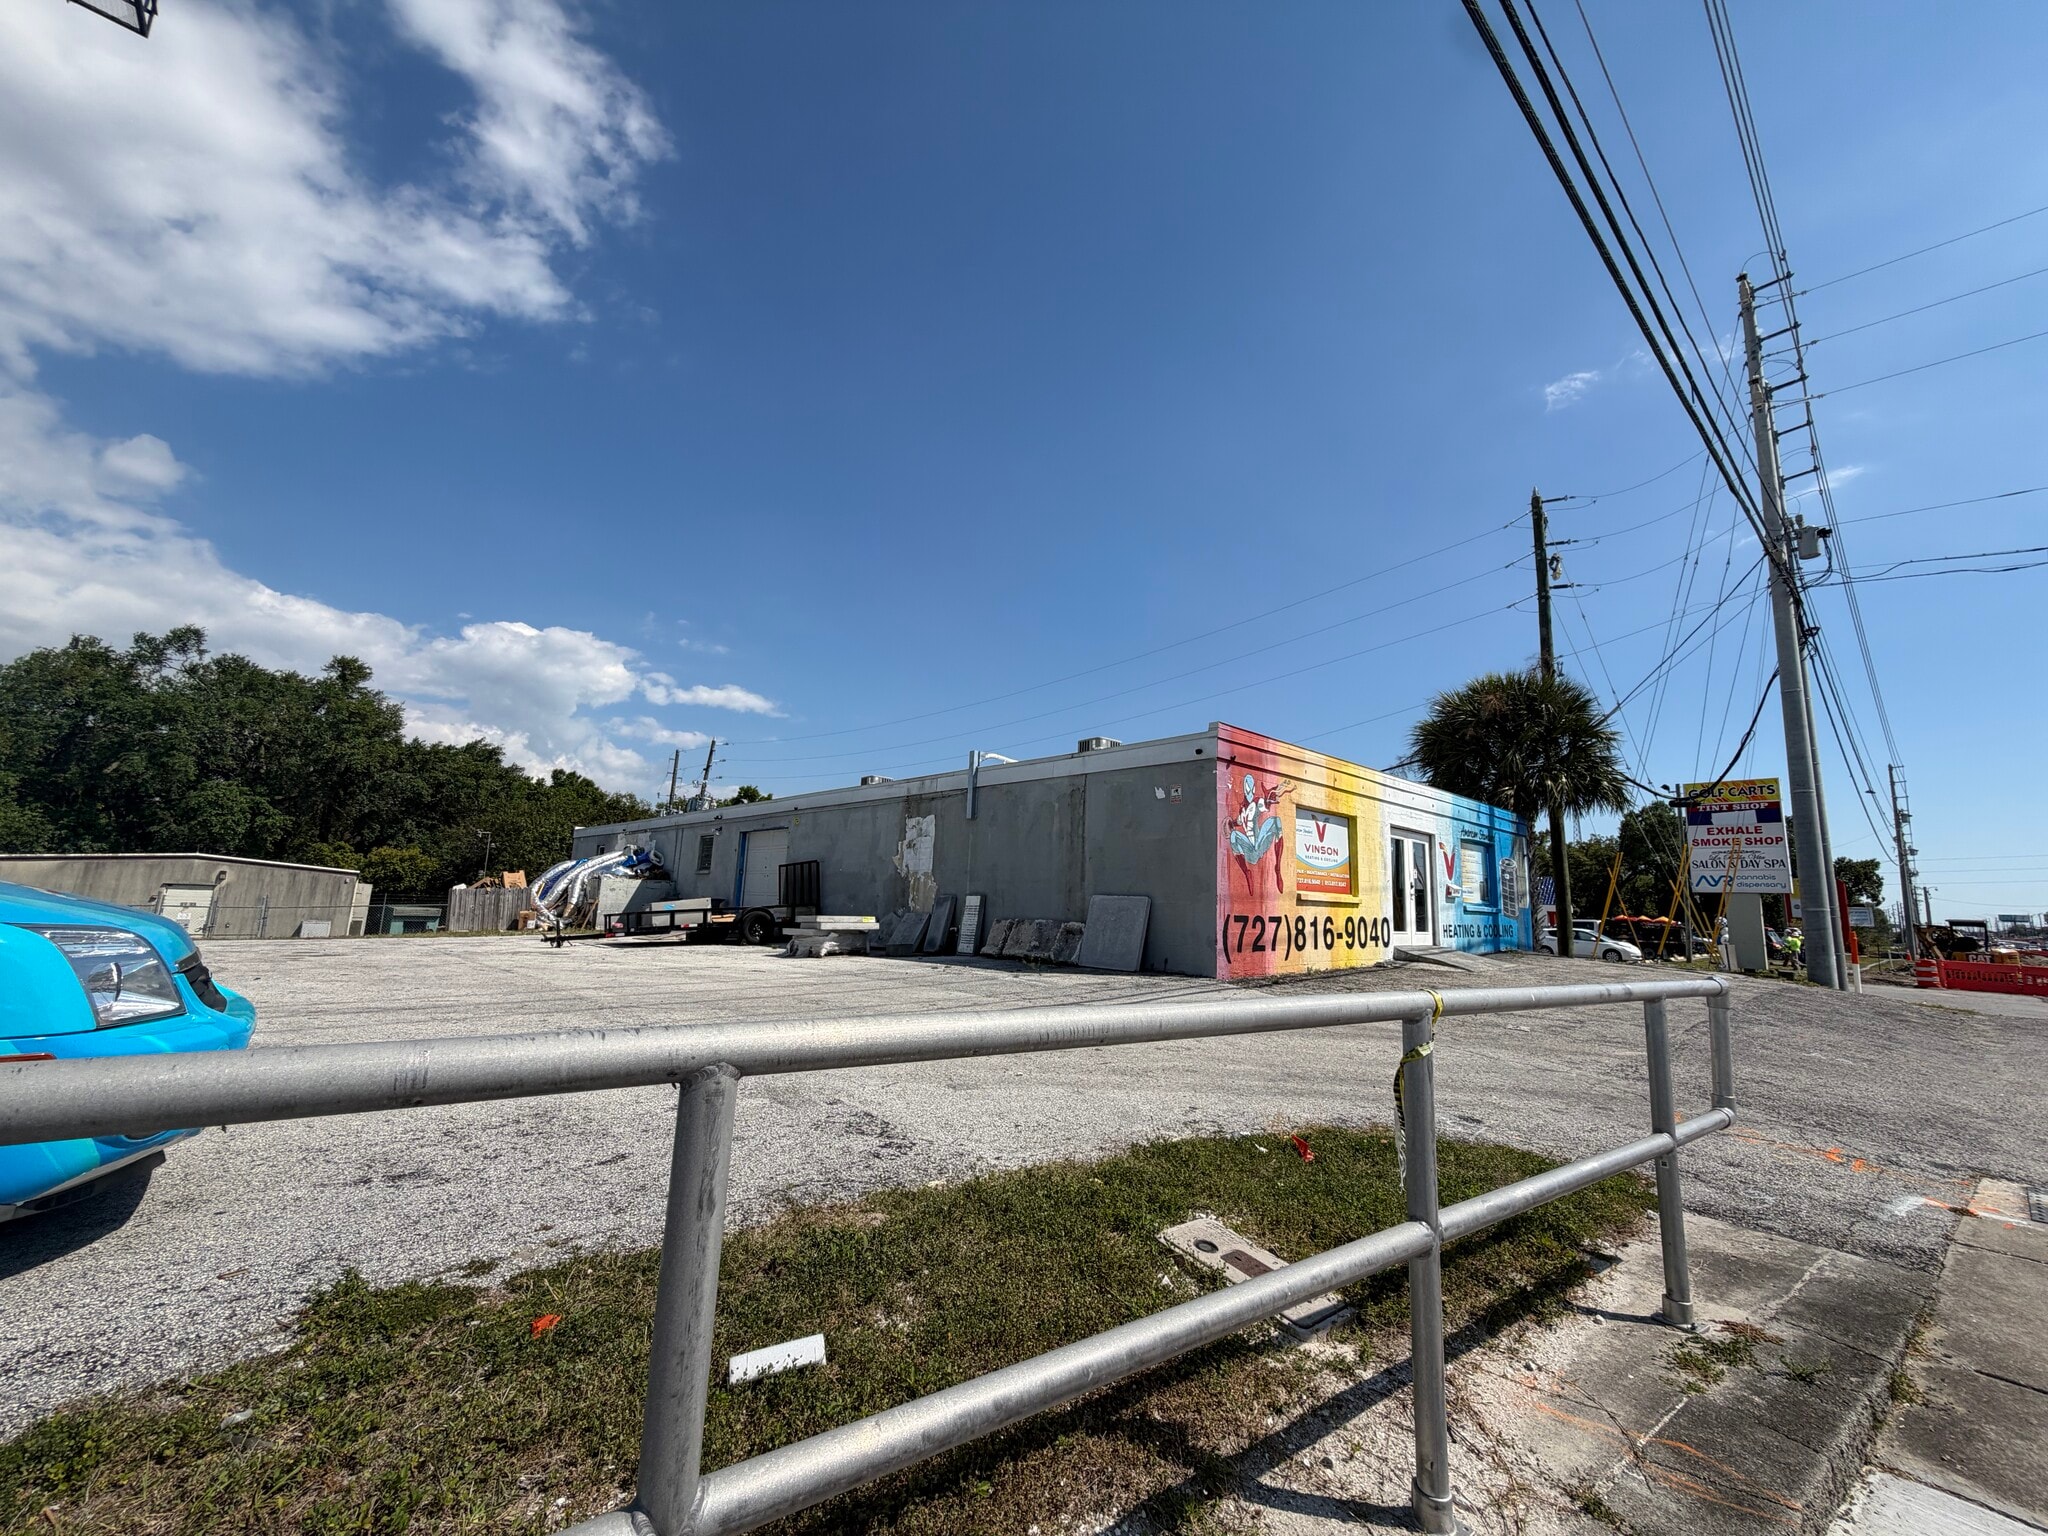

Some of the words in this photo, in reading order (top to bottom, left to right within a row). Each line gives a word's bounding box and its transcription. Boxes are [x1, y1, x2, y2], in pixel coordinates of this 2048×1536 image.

[1688, 788, 1724, 799] GOLF
[1728, 785, 1775, 796] CARTS
[1697, 804, 1729, 812] TINT
[1732, 802, 1769, 811] SHOP
[1706, 826, 1763, 836] EXHALE
[1692, 837, 1742, 847] SMOKE
[1744, 836, 1784, 846] SHOP
[1304, 843, 1338, 856] VINSON
[1692, 860, 1726, 869] SALON
[1740, 859, 1761, 869] DAY
[1764, 859, 1786, 869] SPA
[1736, 881, 1787, 890] dispensary
[1443, 924, 1475, 939] HEATING
[1477, 925, 1482, 938] &
[1483, 923, 1514, 938] COOLING
[1223, 914, 1391, 964] (727)816-9040
[1968, 954, 1992, 963] CAT
